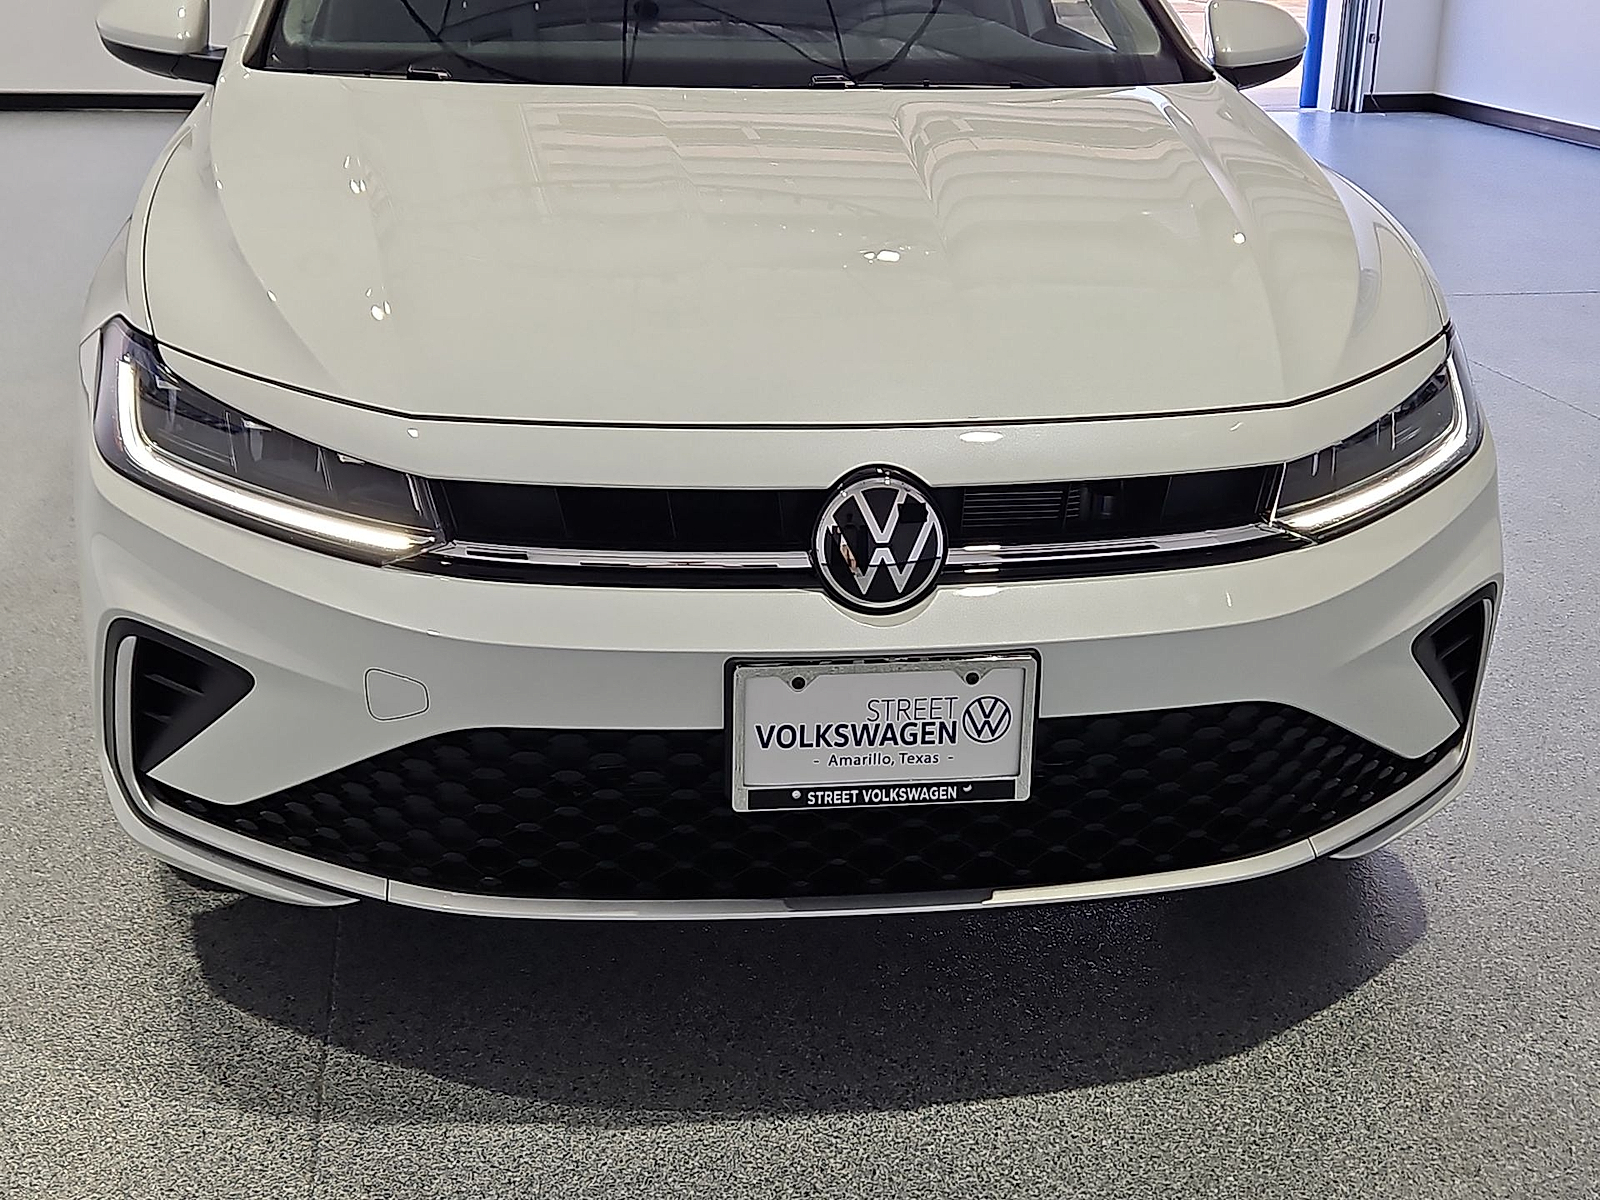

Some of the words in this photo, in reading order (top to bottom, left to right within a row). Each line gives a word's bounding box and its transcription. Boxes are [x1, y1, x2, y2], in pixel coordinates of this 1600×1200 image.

[866, 697, 958, 722] STREET
[755, 720, 957, 748] VOLKSWAGEN
[828, 754, 895, 767] Amarillo,
[899, 753, 939, 765] Texas
[807, 790, 857, 804] STREET
[862, 786, 957, 802] VOLKSWAGEN
